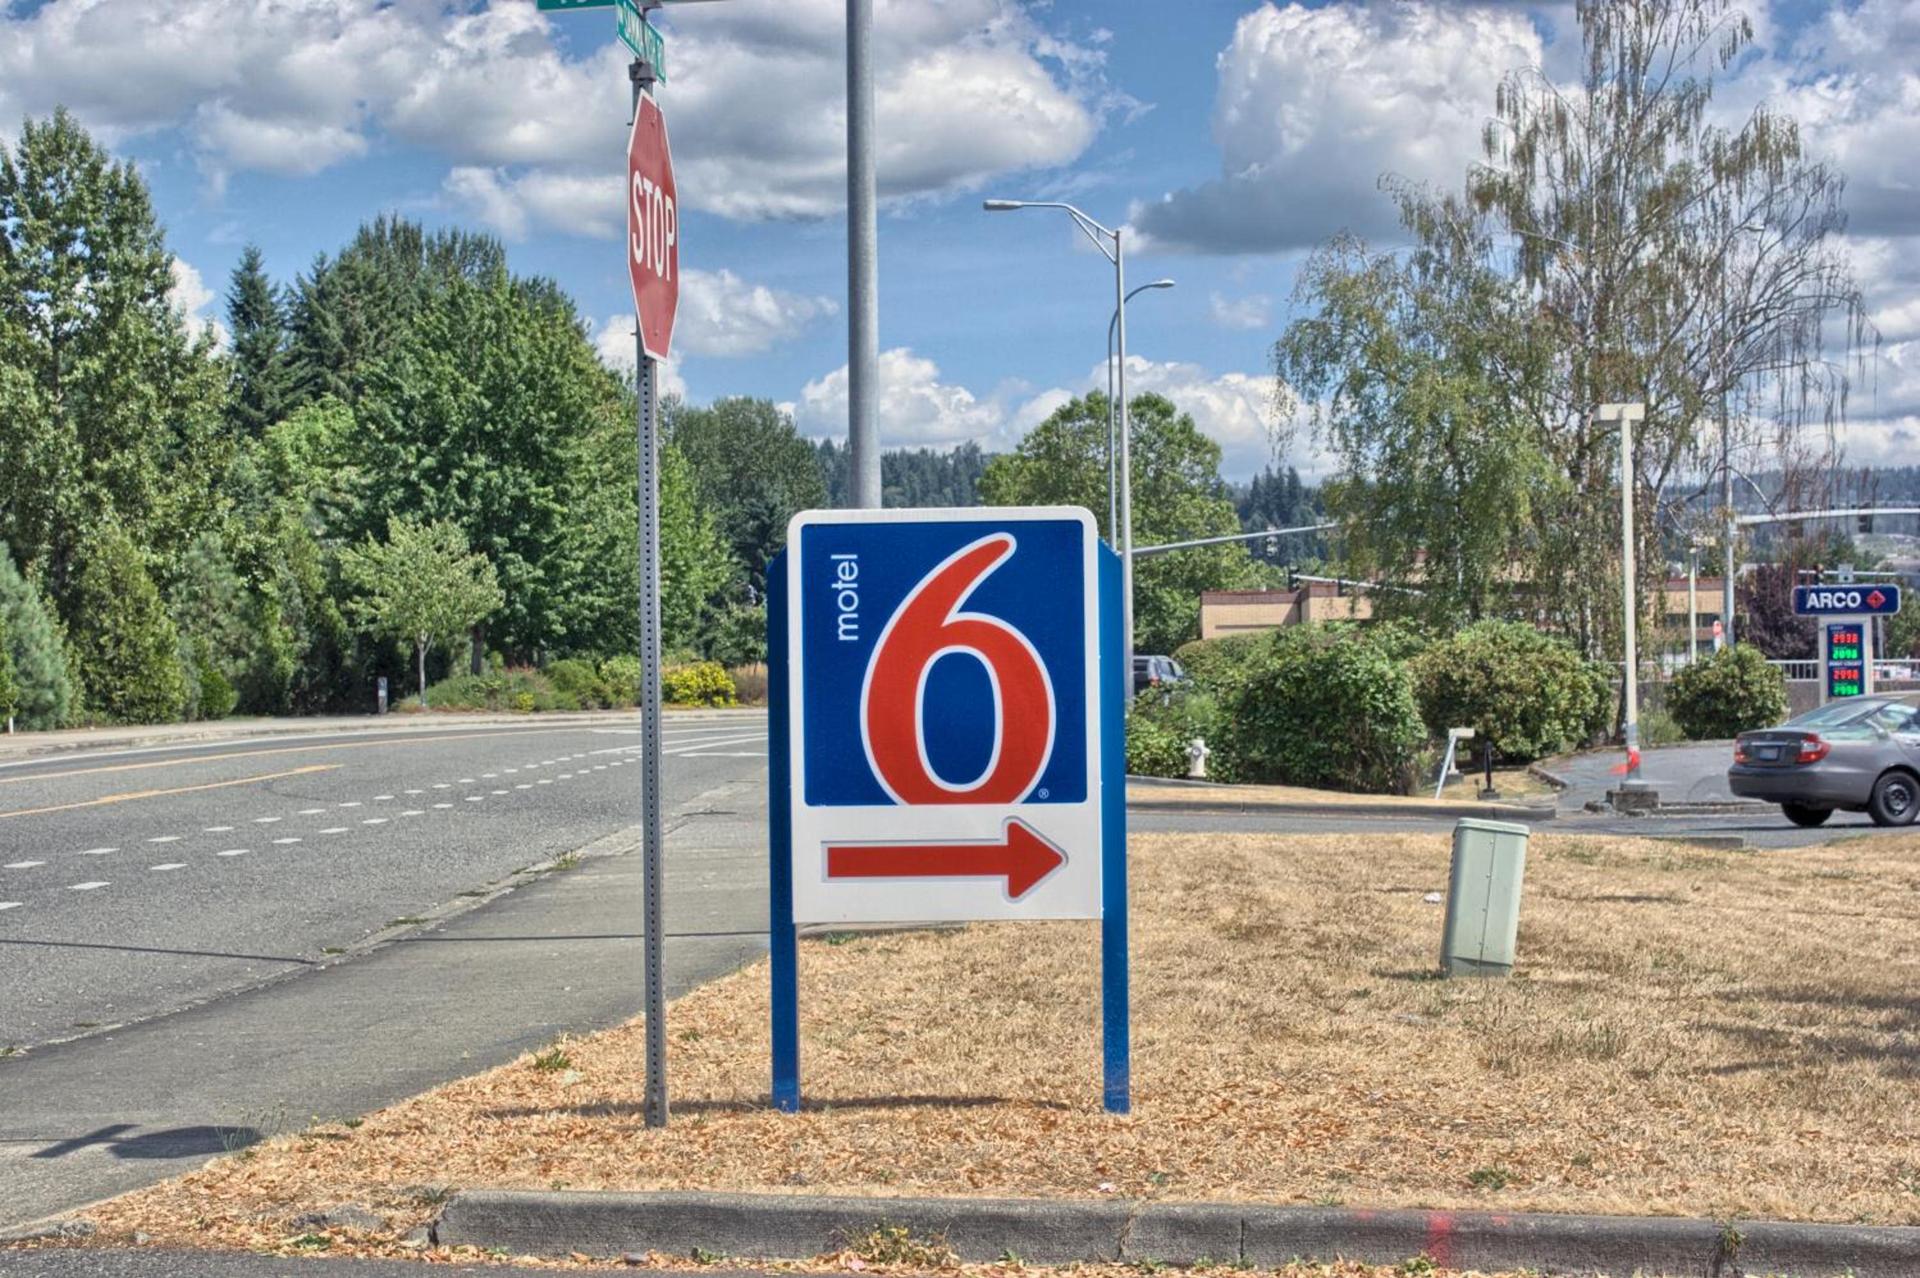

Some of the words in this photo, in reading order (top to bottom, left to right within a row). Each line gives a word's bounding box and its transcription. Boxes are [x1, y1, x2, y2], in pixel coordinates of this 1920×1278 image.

[632, 170, 675, 282] STOP
[831, 554, 859, 641] motel
[1806, 591, 1861, 609] ARCO
[860, 532, 1056, 805] 6
